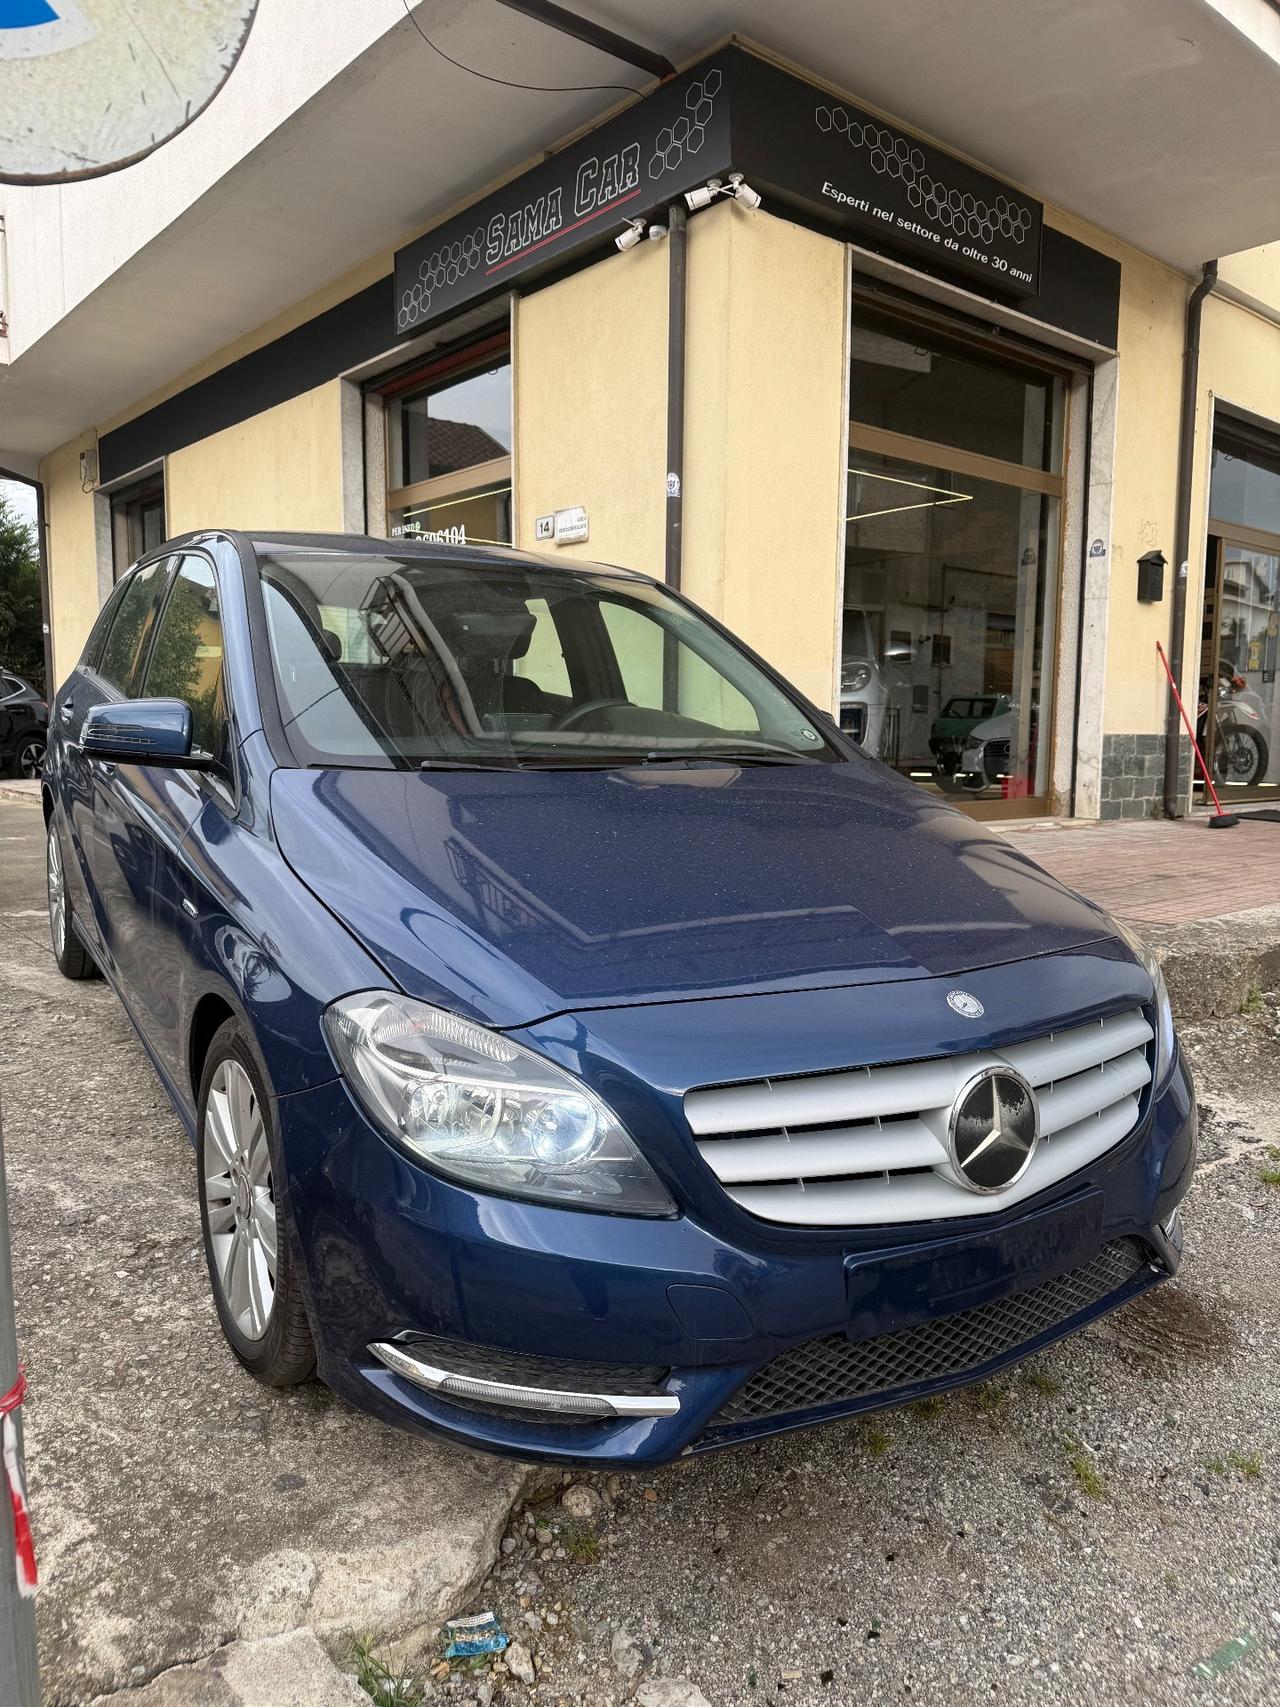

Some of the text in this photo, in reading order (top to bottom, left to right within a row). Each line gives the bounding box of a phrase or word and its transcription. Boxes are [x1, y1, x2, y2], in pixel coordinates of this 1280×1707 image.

[486, 142, 641, 265] SAMA CAR
[821, 181, 1033, 283] Esperti nel settore da oltre 30 anni
[540, 521, 550, 534] 14
